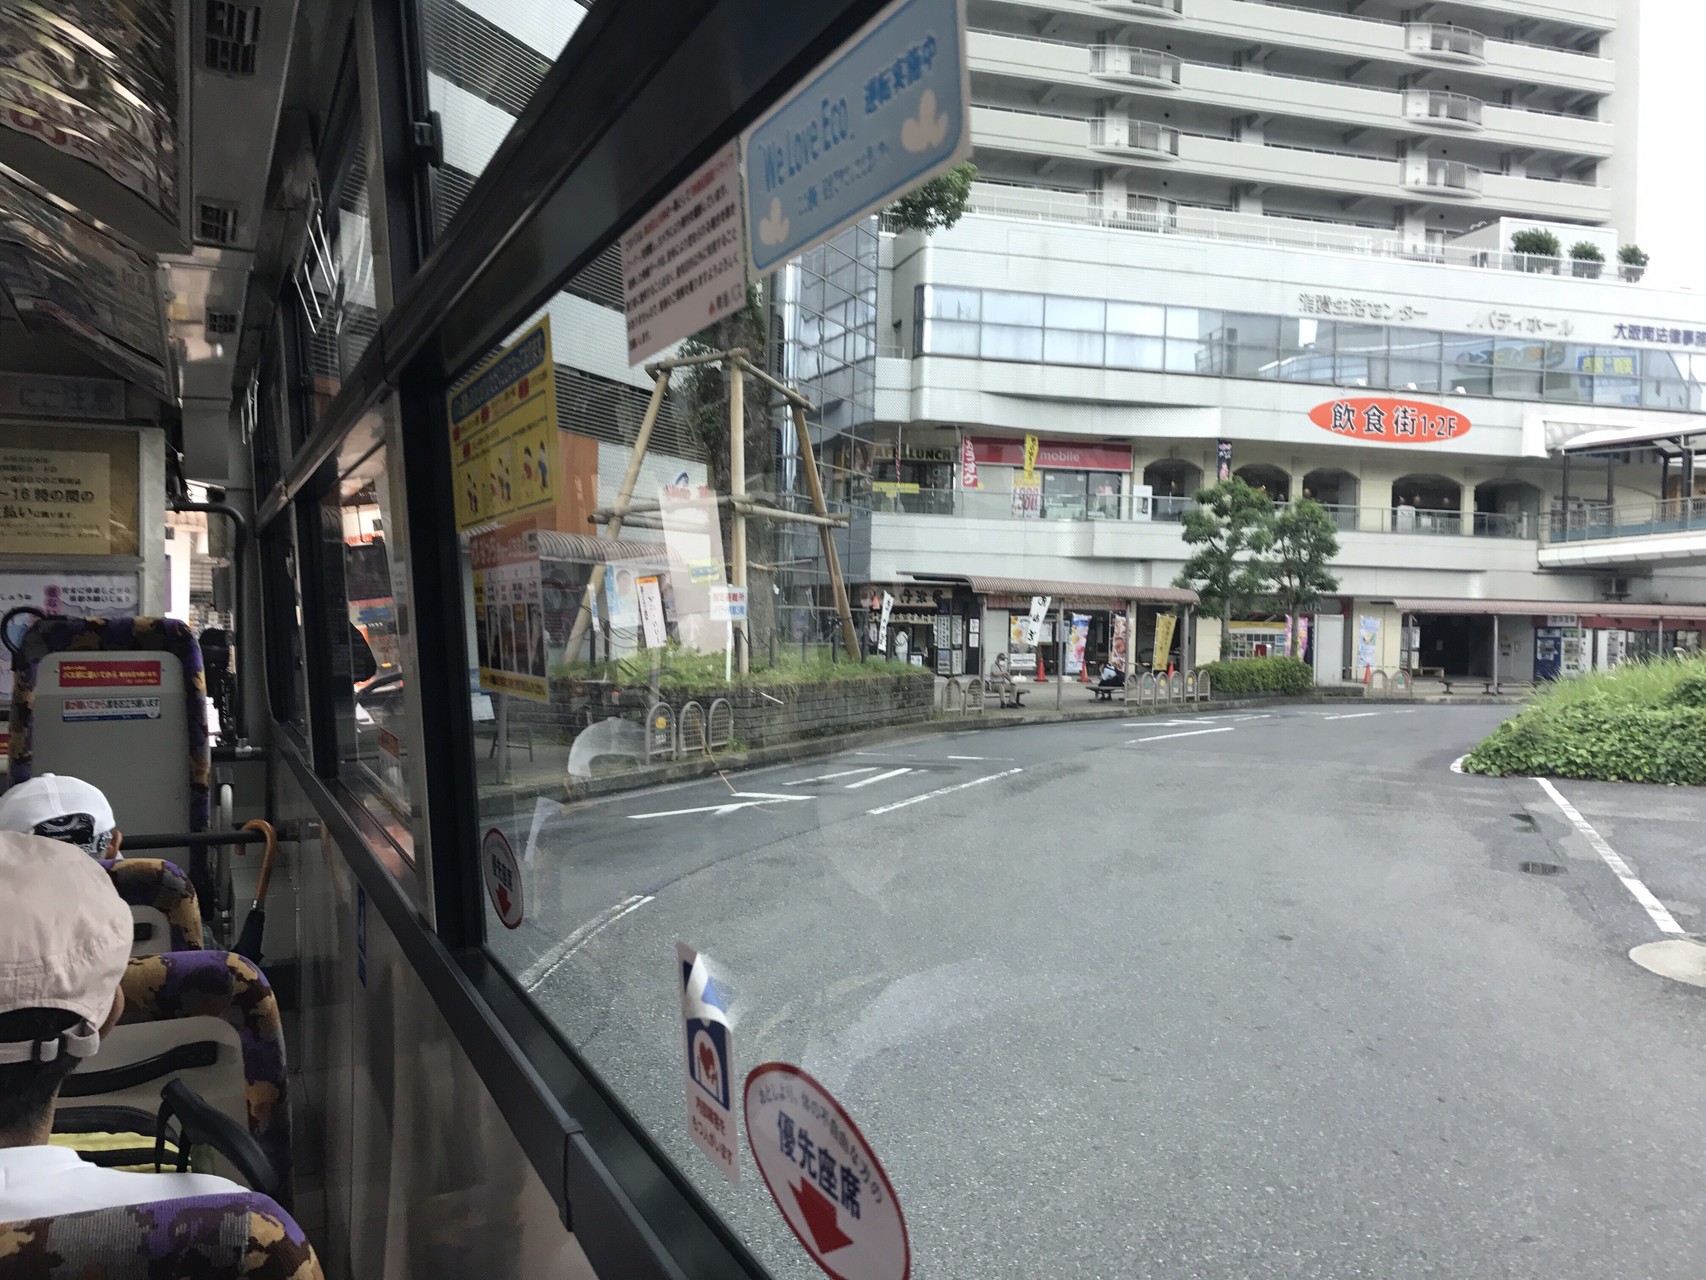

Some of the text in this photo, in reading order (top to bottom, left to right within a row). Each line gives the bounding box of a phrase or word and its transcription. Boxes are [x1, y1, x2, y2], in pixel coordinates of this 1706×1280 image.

[758, 141, 784, 193] We
[1299, 293, 1428, 321] 消費生活センター
[777, 1109, 861, 1220] 優先座席
